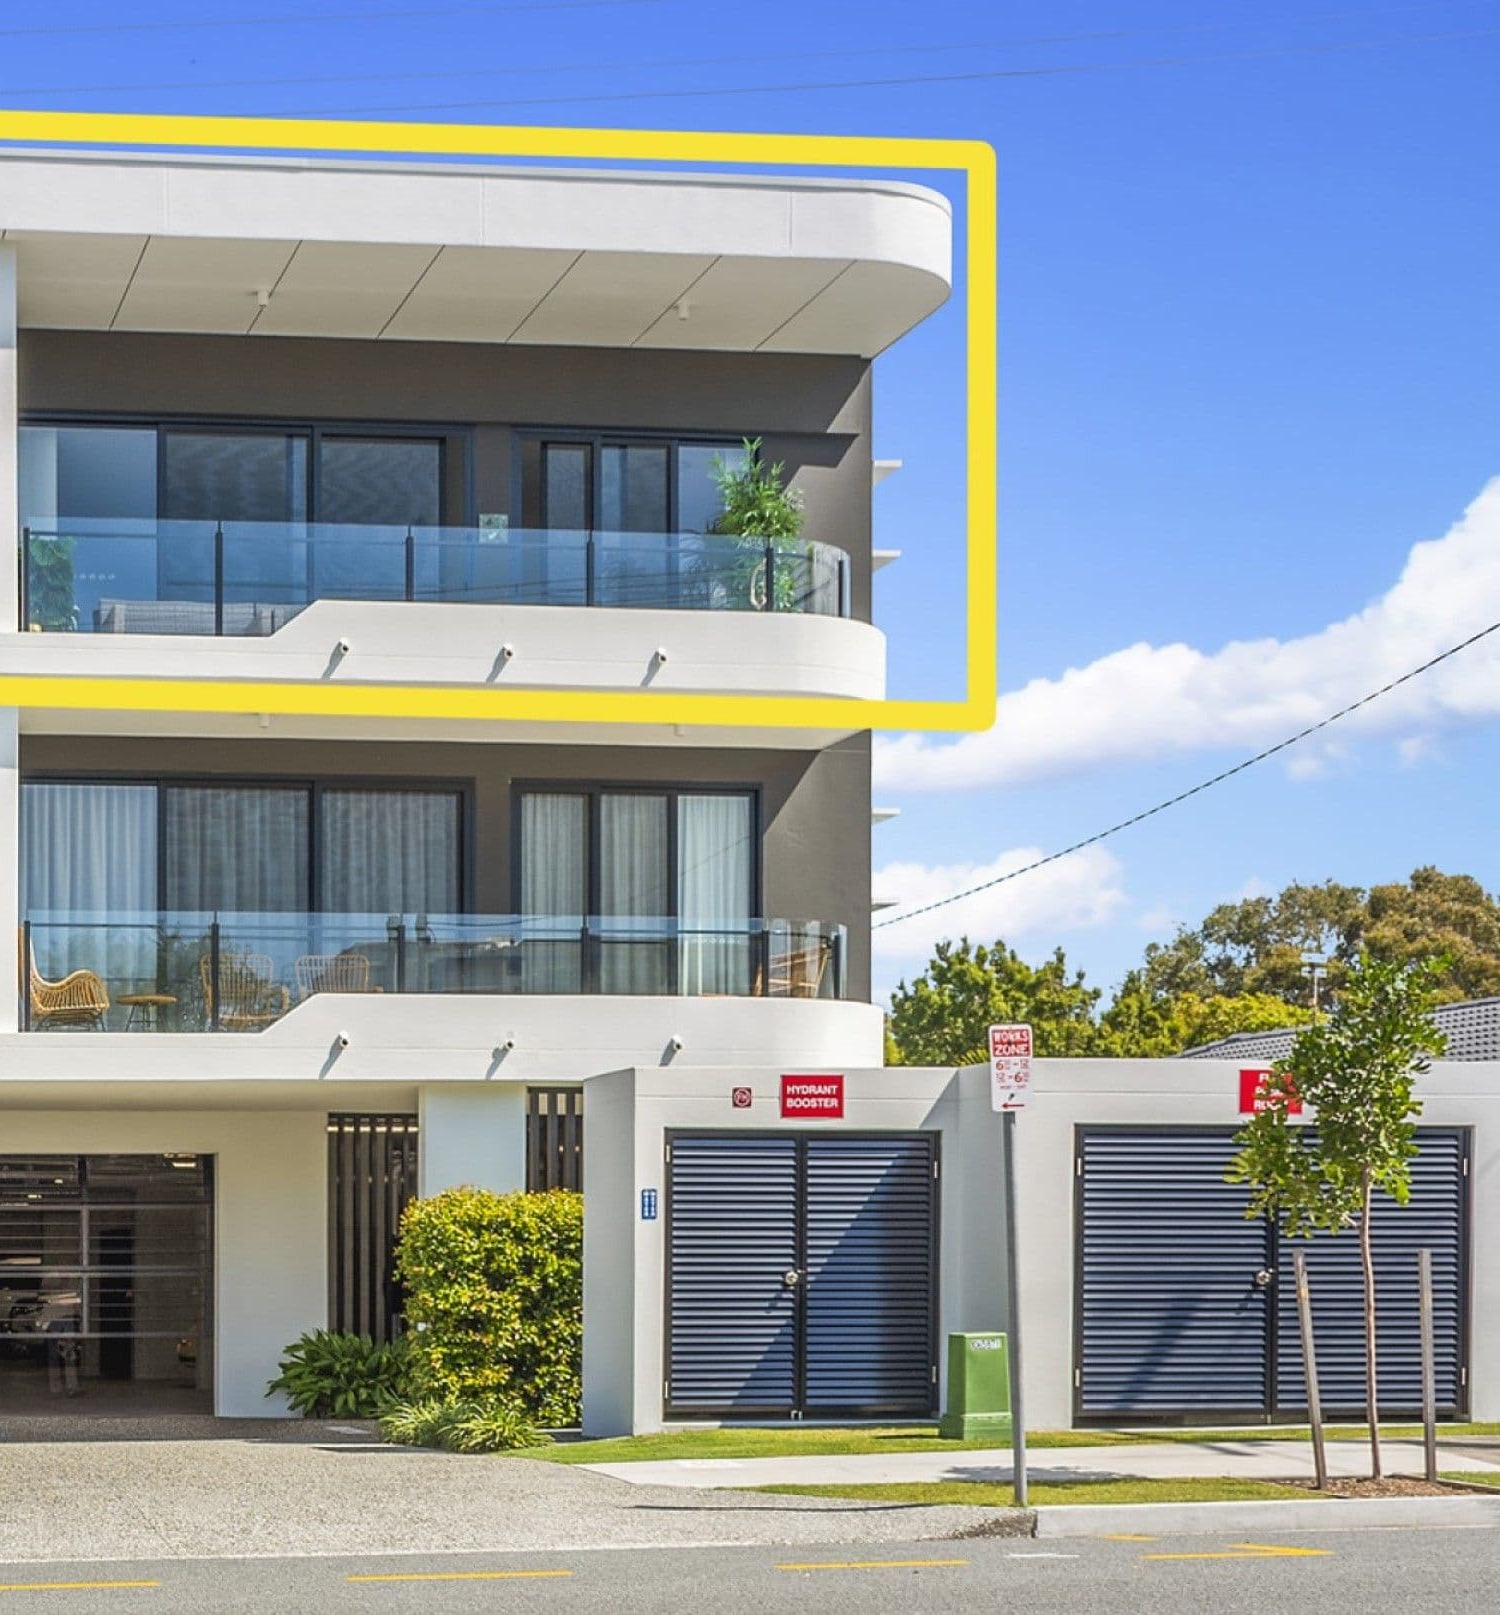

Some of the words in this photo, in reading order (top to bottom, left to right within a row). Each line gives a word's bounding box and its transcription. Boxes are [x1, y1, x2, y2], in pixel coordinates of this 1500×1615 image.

[995, 1044, 1029, 1056] ZONE
[786, 1084, 839, 1095] HYDRANT
[786, 1097, 839, 1108] BOOSTER
